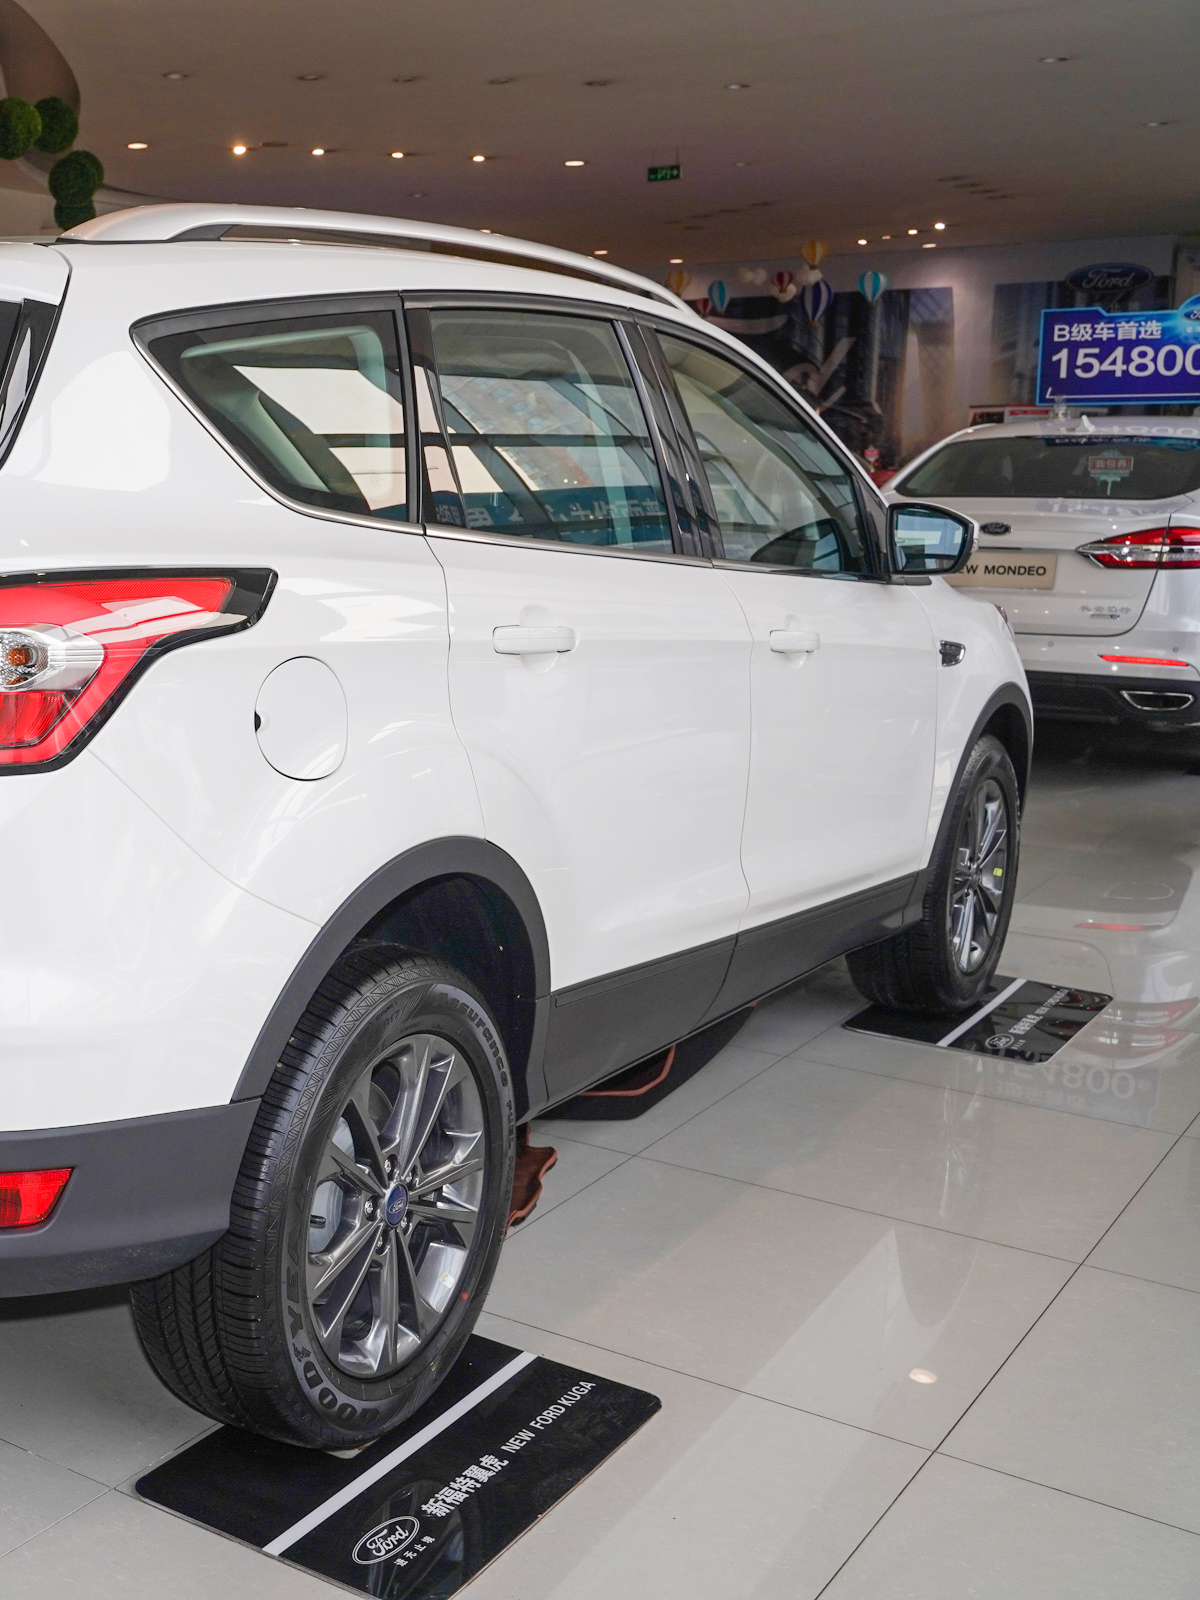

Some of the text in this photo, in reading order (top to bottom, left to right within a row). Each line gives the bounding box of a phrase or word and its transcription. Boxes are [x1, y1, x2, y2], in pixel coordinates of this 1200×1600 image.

[1082, 268, 1136, 288] Ford
[1053, 320, 1162, 343] B级车首选
[984, 565, 1047, 577] MONDEO
[421, 1380, 597, 1518] 新福特翼虎 NEW FORD KUGA
[366, 1525, 410, 1557] Ford
